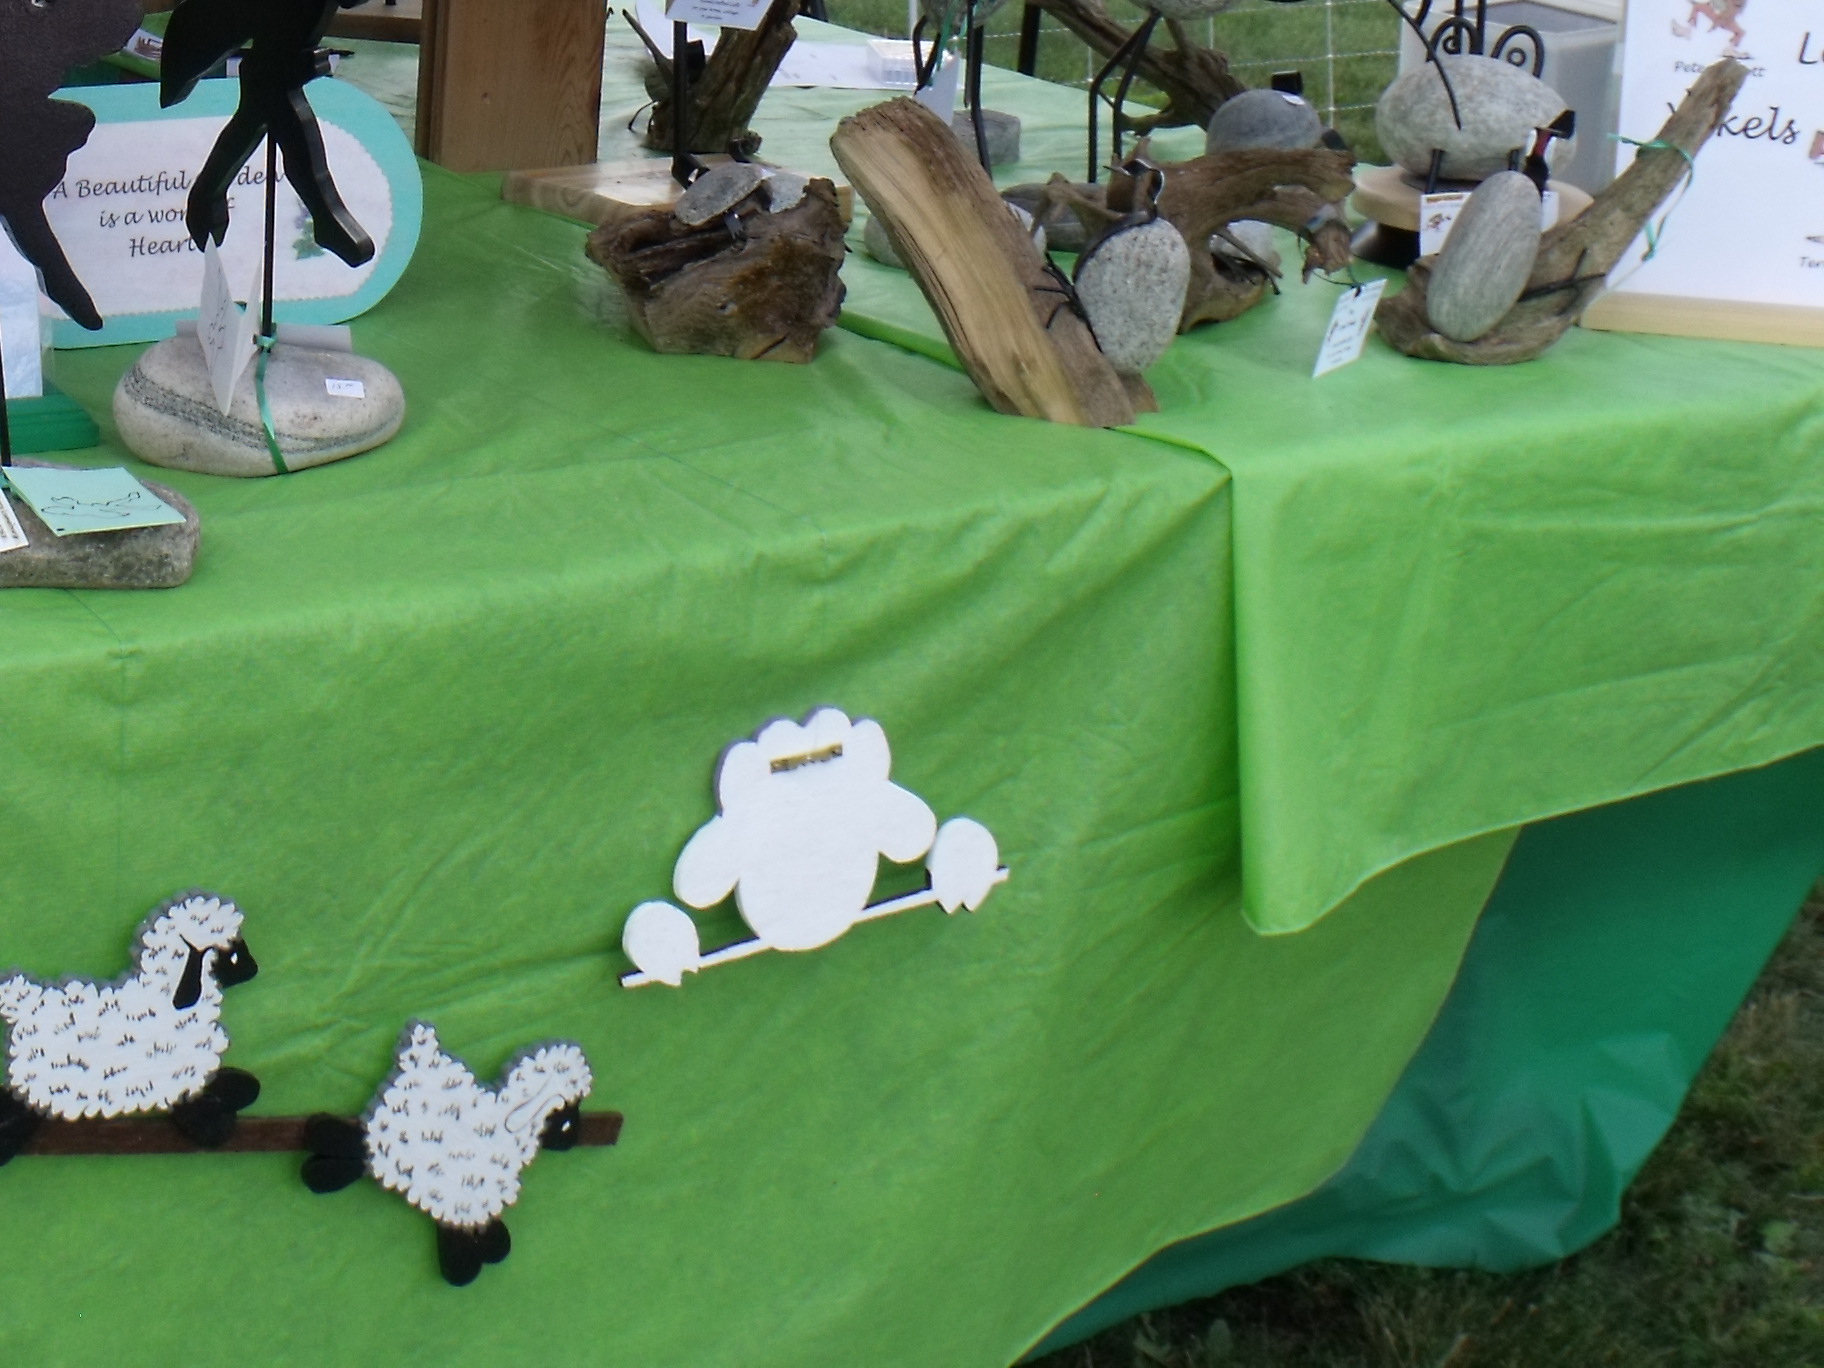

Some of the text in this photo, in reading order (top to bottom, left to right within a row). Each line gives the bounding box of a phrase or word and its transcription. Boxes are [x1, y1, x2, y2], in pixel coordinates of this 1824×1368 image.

[1667, 102, 1801, 146] kels
[53, 169, 191, 200] A Beautiful
[98, 208, 145, 229] is a
[128, 235, 197, 259] Heart
